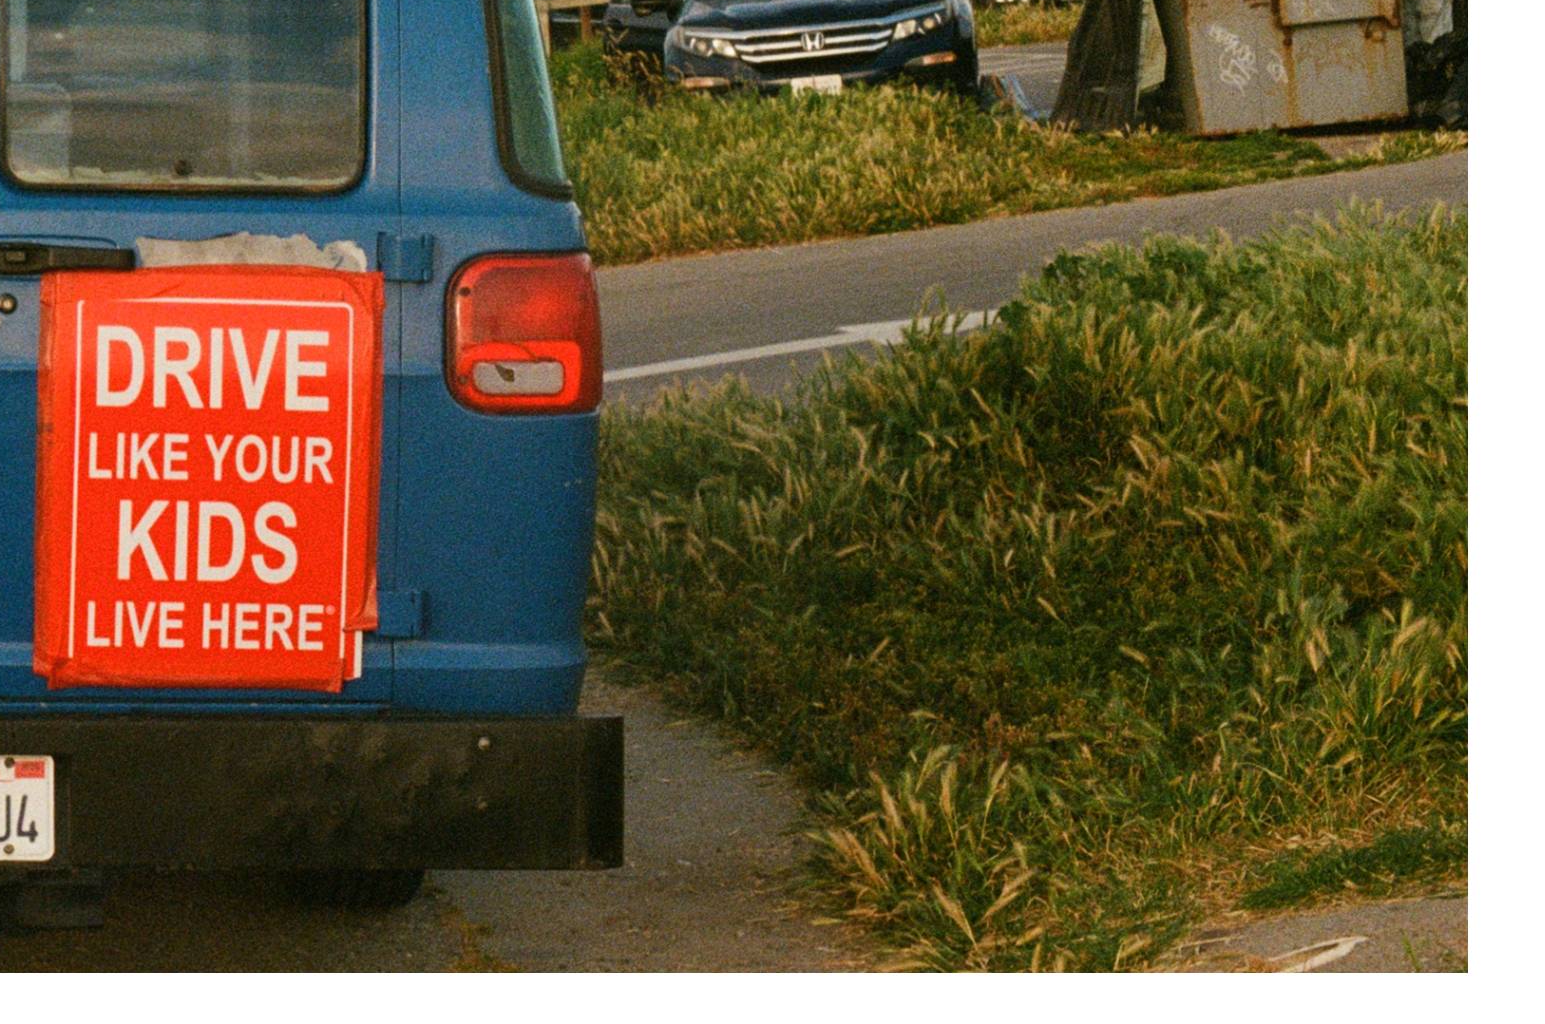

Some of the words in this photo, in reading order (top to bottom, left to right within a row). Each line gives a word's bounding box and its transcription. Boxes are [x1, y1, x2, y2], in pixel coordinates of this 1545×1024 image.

[95, 324, 330, 413] DRIVE
[88, 432, 190, 481] LIKE
[205, 433, 334, 484] YOUR
[116, 499, 299, 585] KIDS
[86, 600, 185, 649] LIVE
